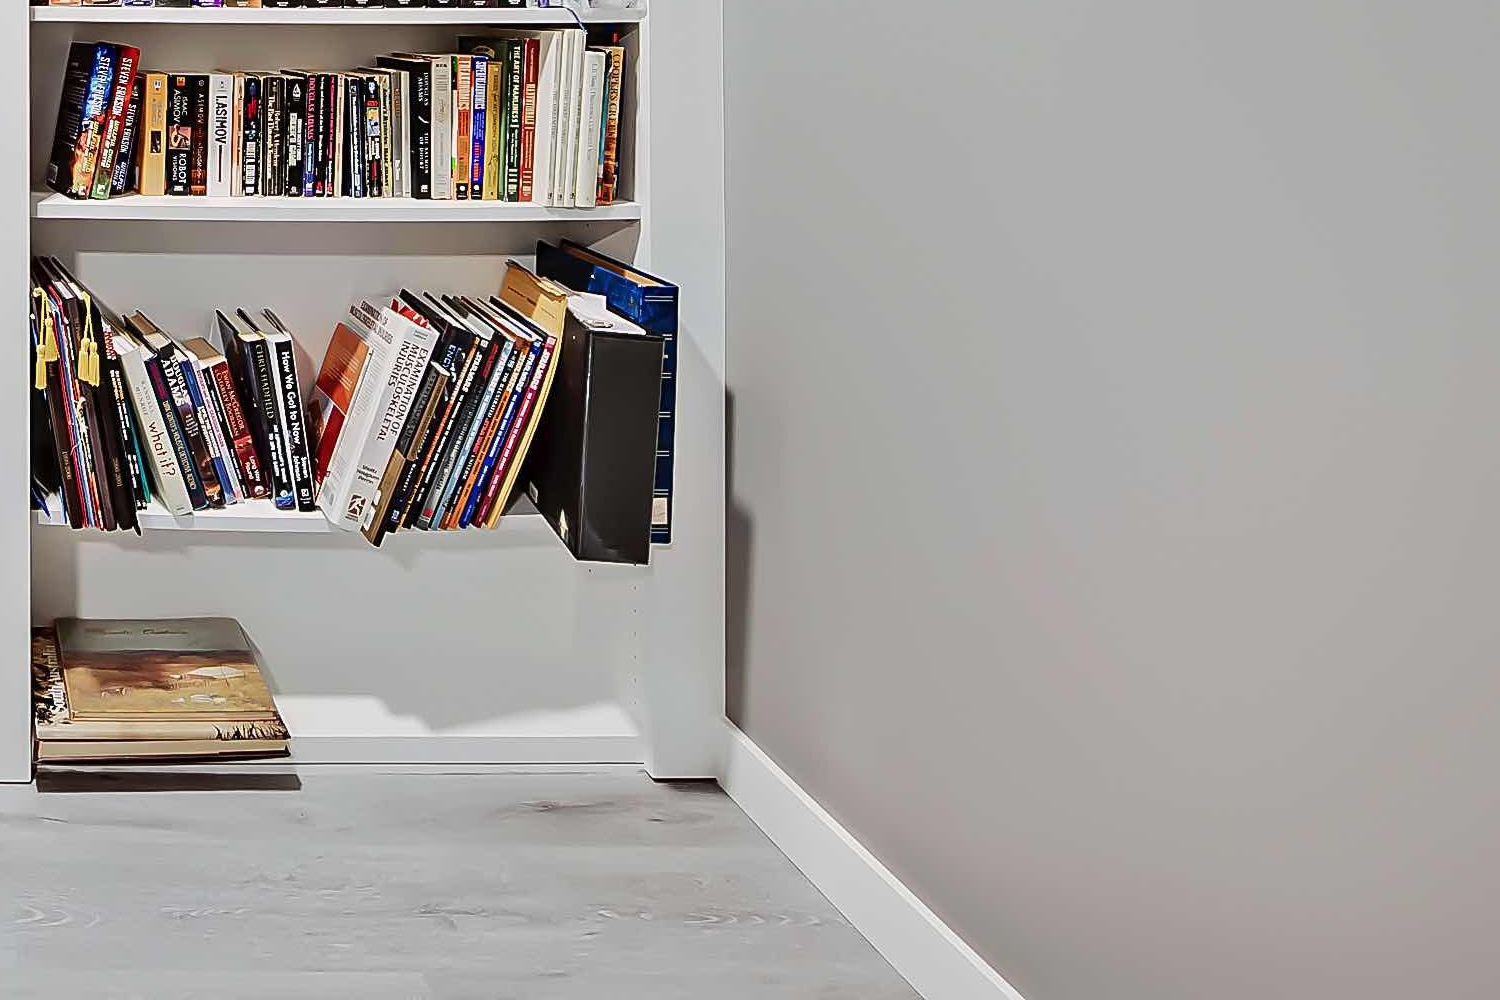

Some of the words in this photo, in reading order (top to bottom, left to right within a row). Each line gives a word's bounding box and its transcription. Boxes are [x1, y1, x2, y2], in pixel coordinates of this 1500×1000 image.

[97, 57, 110, 83] STEVEN
[119, 58, 132, 84] STEVEN
[609, 55, 621, 101] COOPER'S
[112, 86, 126, 117] ERIKSON
[126, 104, 137, 126] STEVEN
[173, 89, 181, 122] ASIMOV
[119, 128, 132, 153] ERIKSON
[178, 154, 186, 183] ROBOT
[255, 344, 266, 372] CHRIS
[281, 351, 290, 372] How
[388, 340, 411, 388] INJURIES
[161, 359, 185, 407] ADAMS
[170, 355, 191, 405] DOUGLAS
[284, 374, 294, 389] We
[376, 344, 419, 441] MUSCULOSKELETAL
[395, 347, 429, 421] EXAMINATION
[259, 375, 275, 419] HADFIELD
[287, 392, 296, 408] Got
[290, 411, 298, 420] to
[390, 420, 401, 437] OF
[291, 422, 301, 445] Now
[148, 422, 168, 456] what
[159, 458, 176, 476] if?
[249, 456, 258, 469] Long
[245, 462, 254, 479] Round
[253, 469, 261, 481] Way
[48, 684, 65, 712] South
